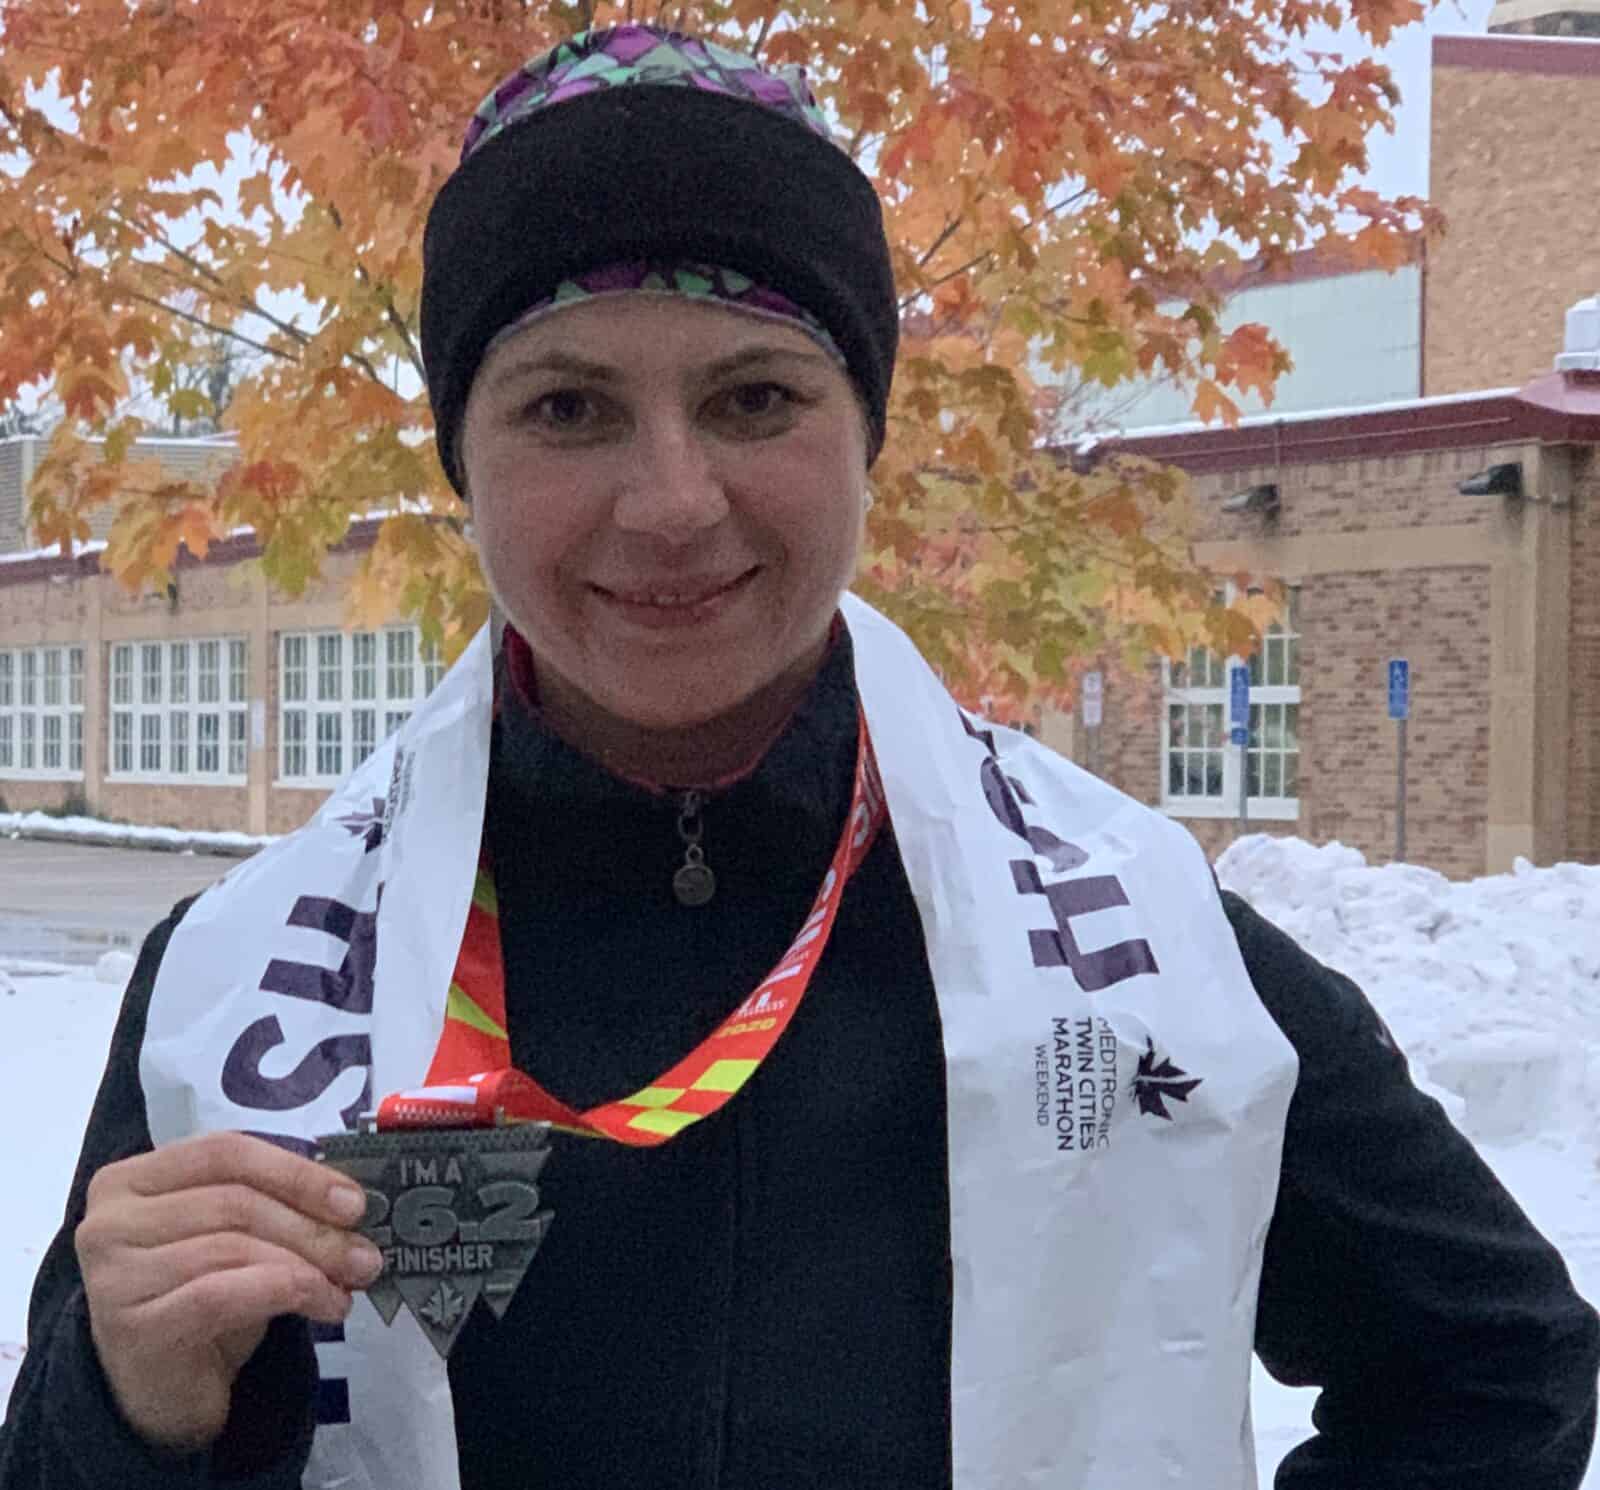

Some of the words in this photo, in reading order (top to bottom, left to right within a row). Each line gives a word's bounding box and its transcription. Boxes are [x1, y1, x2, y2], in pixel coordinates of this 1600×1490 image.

[1075, 1016, 1095, 1072] TWIN
[1033, 1043, 1050, 1127] WEEKEND
[1052, 1017, 1075, 1151] MARATHON
[1077, 1078, 1097, 1150] CITIES
[400, 1157, 438, 1185] I'M
[444, 1156, 462, 1184] A
[382, 1243, 494, 1273] FINISHER
